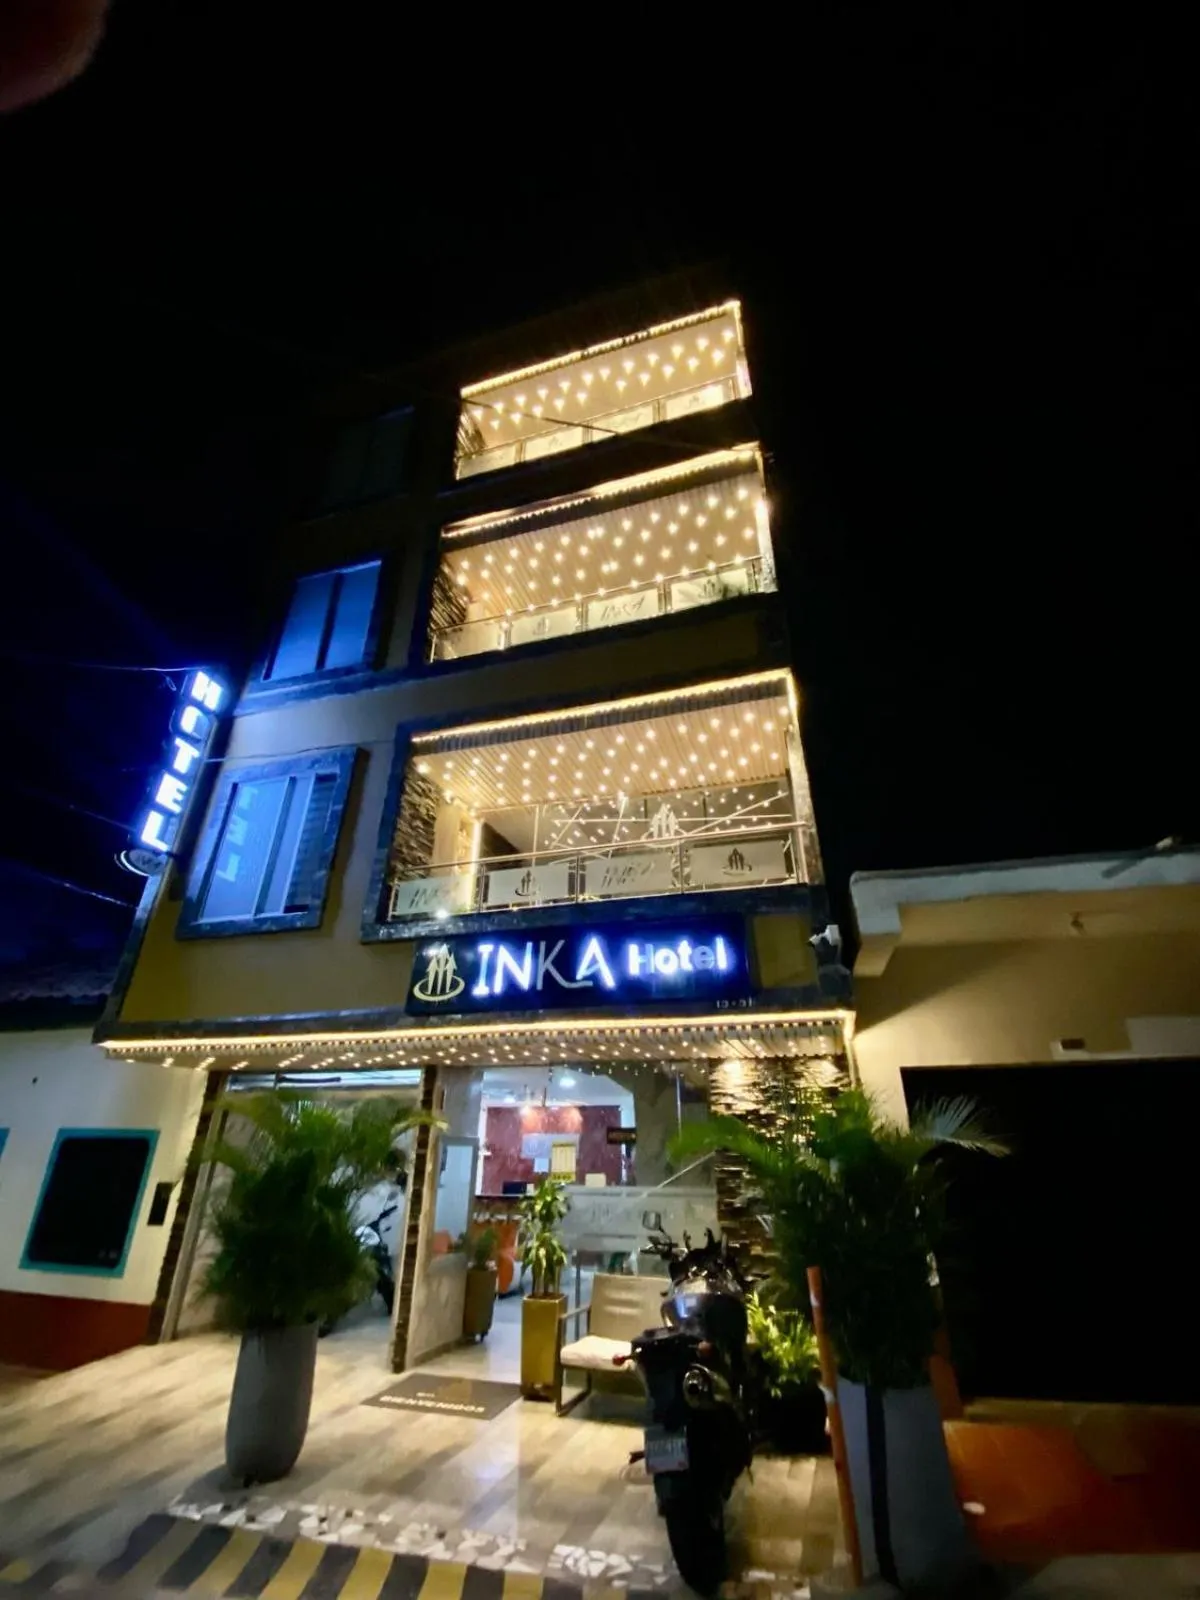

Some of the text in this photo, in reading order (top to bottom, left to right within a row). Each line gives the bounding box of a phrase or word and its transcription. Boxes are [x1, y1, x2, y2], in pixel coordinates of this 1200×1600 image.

[141, 671, 223, 853] HOTEL
[472, 936, 730, 997] INKA Hotel
